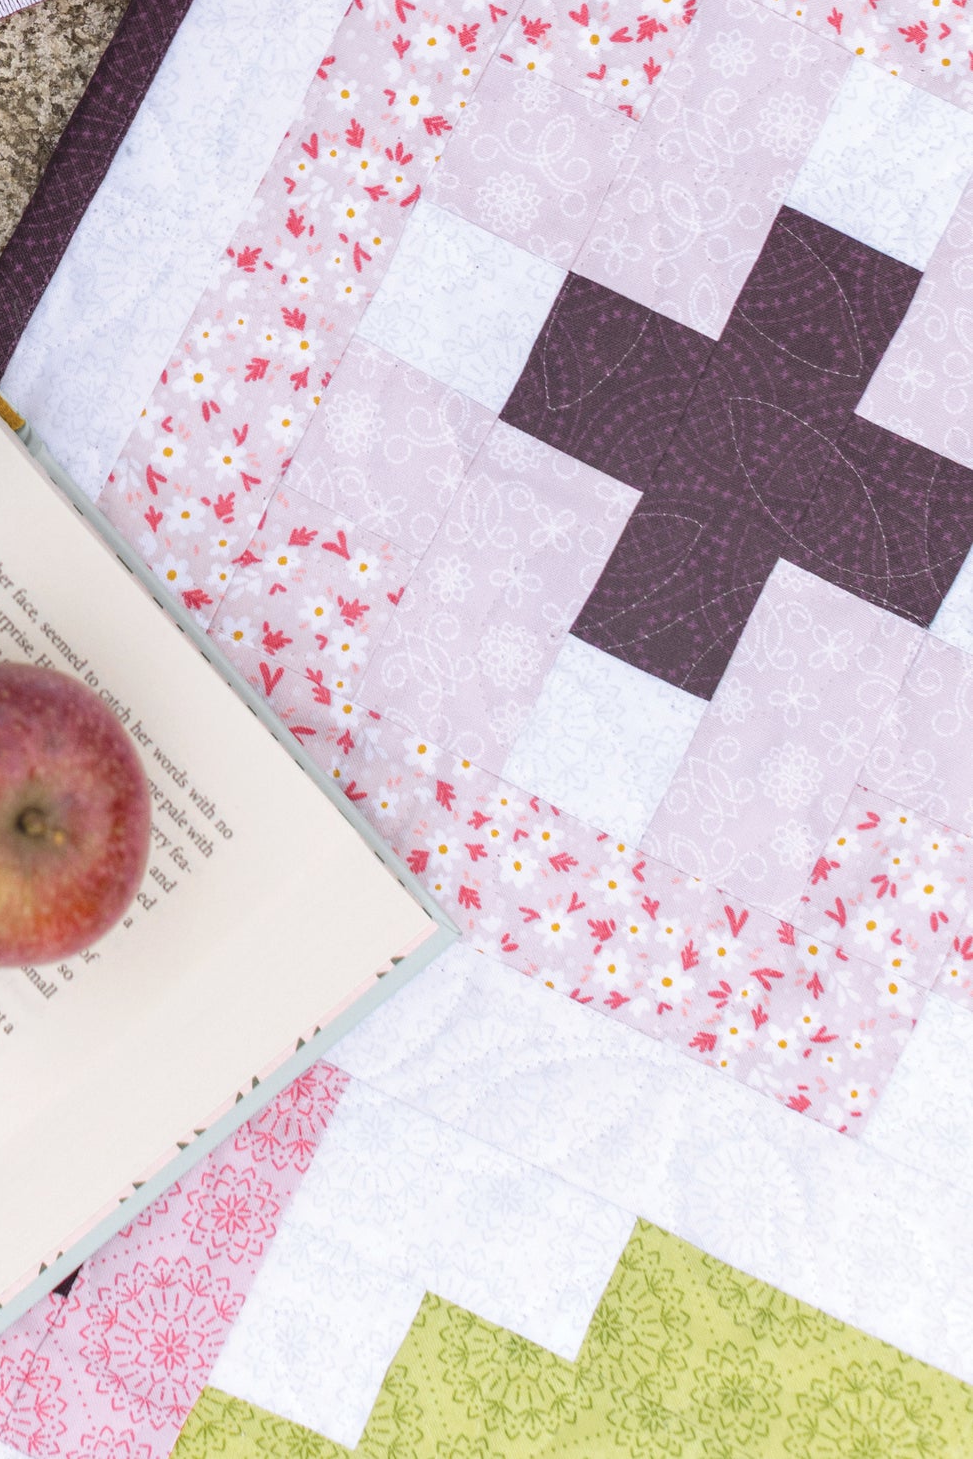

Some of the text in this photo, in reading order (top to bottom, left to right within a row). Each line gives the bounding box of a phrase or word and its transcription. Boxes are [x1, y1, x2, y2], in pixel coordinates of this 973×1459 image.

[11, 588, 38, 624] face,
[39, 621, 88, 672] seemed
[83, 669, 99, 688] to
[96, 688, 132, 726] catch
[128, 719, 153, 747] her
[152, 746, 188, 789] words
[188, 787, 216, 820] with
[213, 819, 233, 840] no
[157, 798, 214, 859] pale with
[149, 865, 178, 894] and
[56, 963, 74, 981] so
